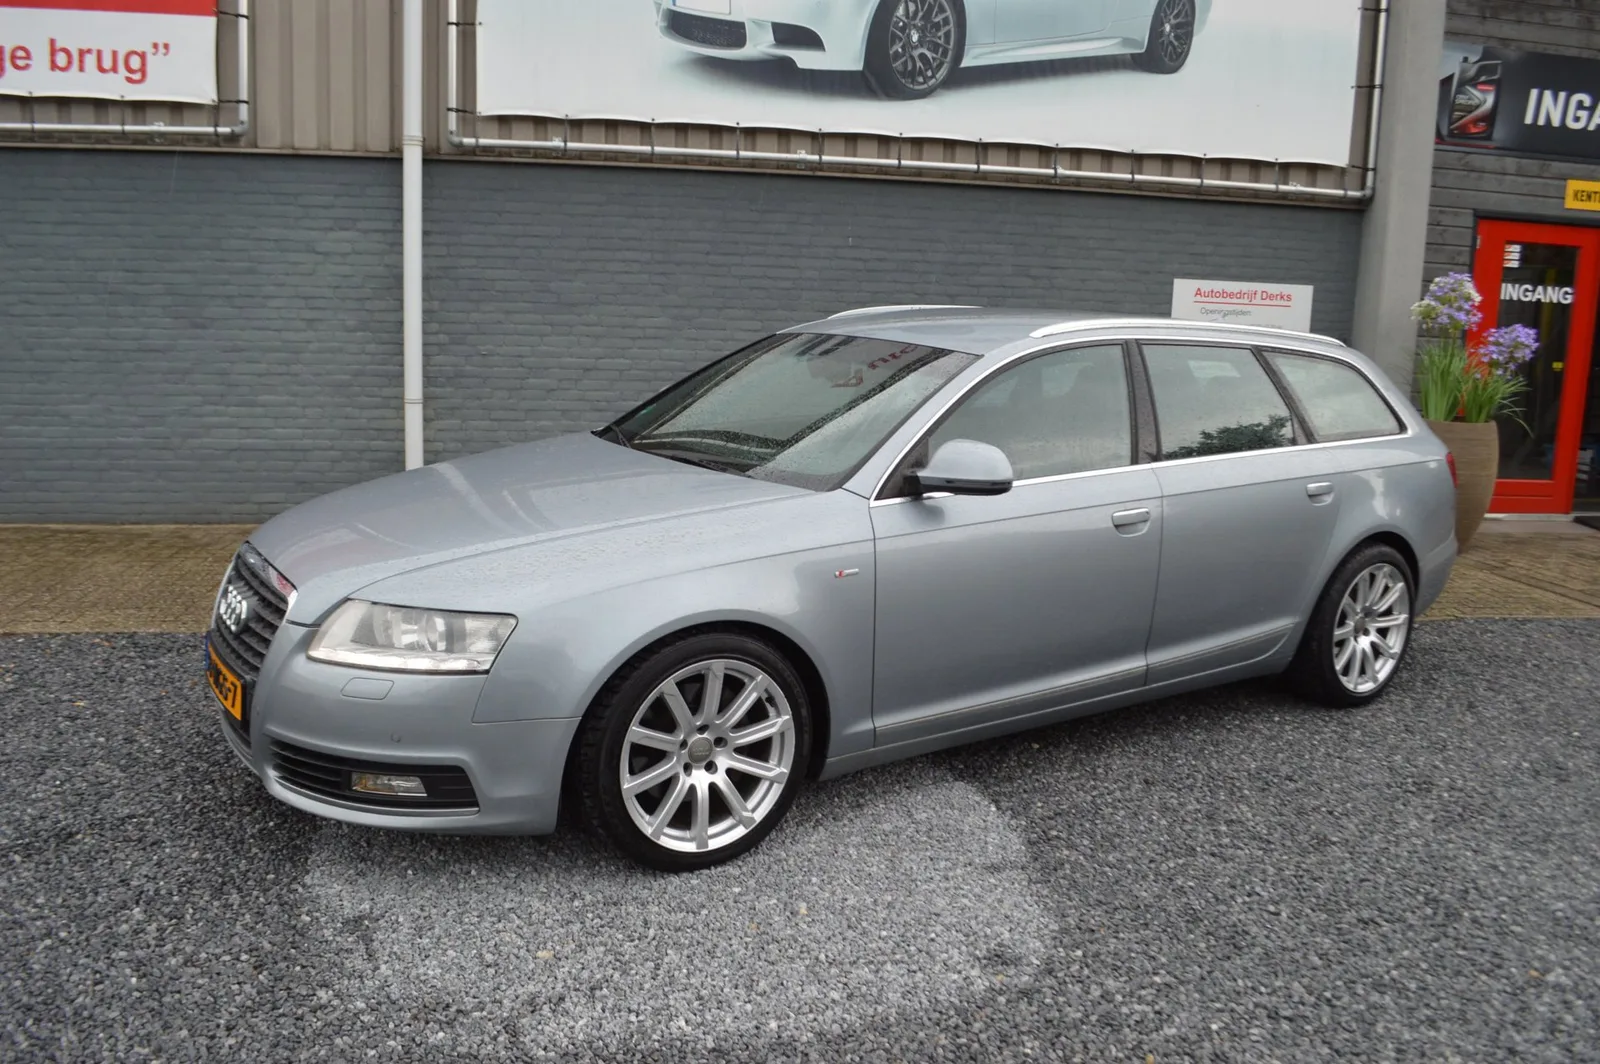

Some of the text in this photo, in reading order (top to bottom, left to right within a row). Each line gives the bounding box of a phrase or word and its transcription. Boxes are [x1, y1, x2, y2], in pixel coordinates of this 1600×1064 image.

[0, 45, 32, 80] e
[1573, 189, 1600, 204] KENT
[1194, 287, 1292, 302] Autobedrijf Derks
[1500, 282, 1575, 305] INGANG
